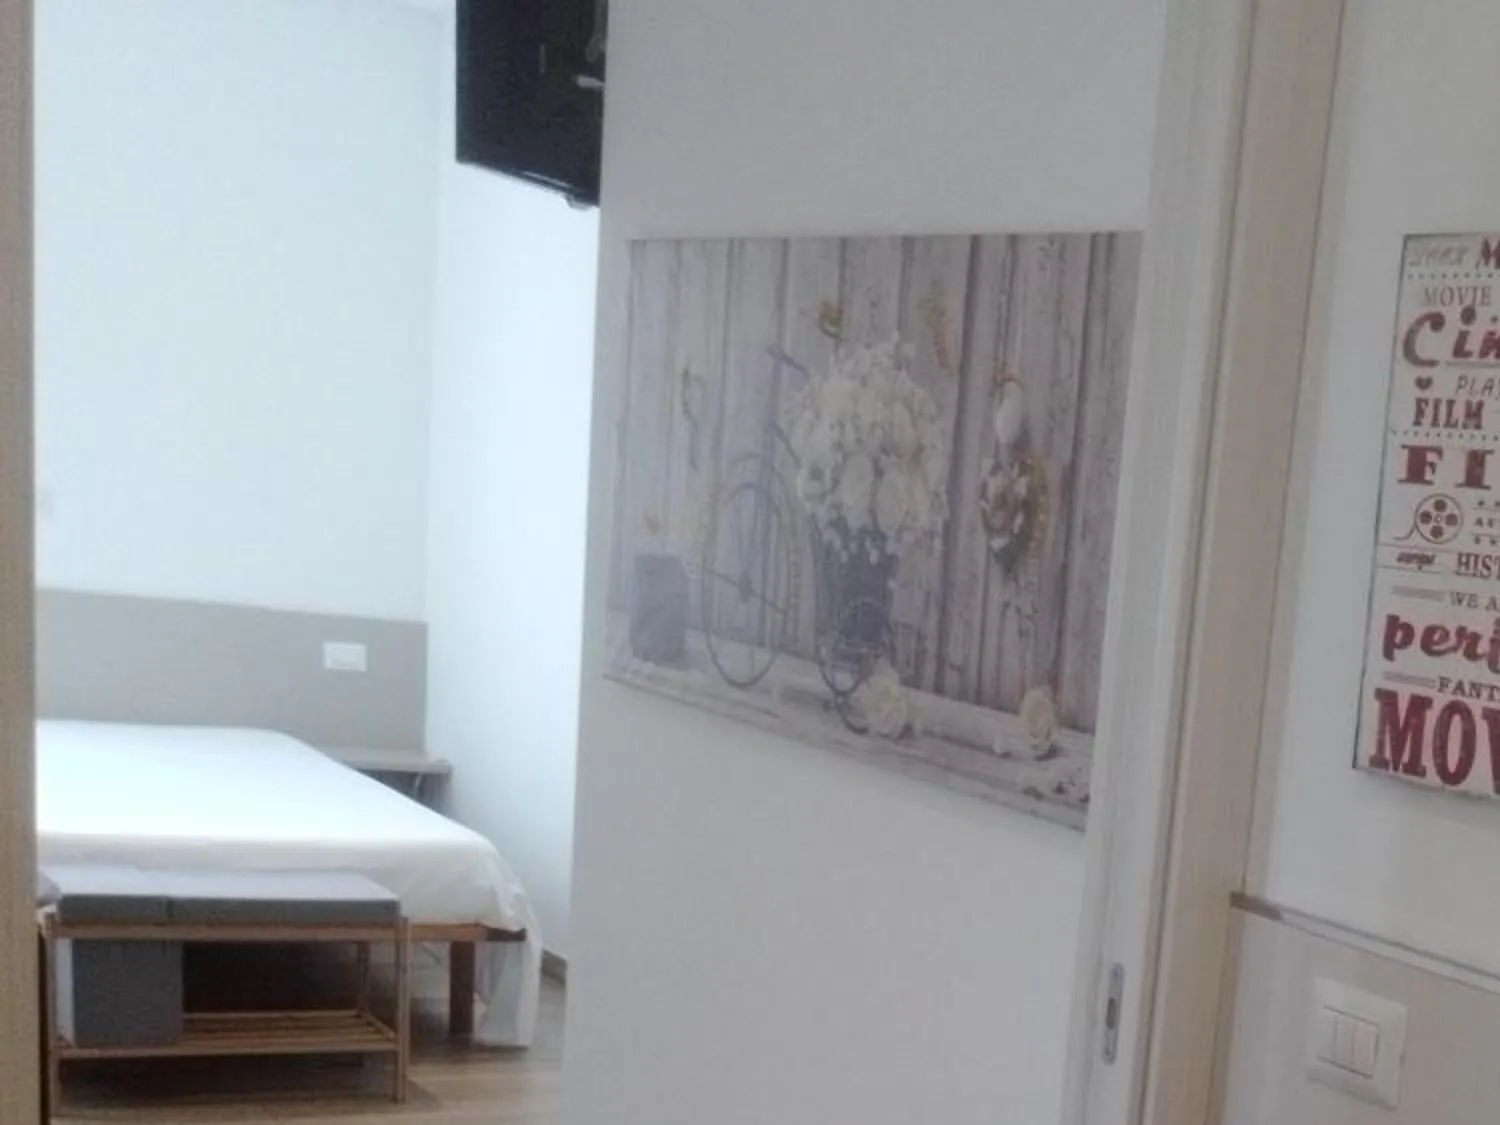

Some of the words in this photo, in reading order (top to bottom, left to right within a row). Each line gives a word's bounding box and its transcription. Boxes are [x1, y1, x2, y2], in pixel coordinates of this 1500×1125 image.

[1423, 285, 1493, 307] MOVIE
[1412, 397, 1485, 430] FILM
[1451, 591, 1479, 610] WE
